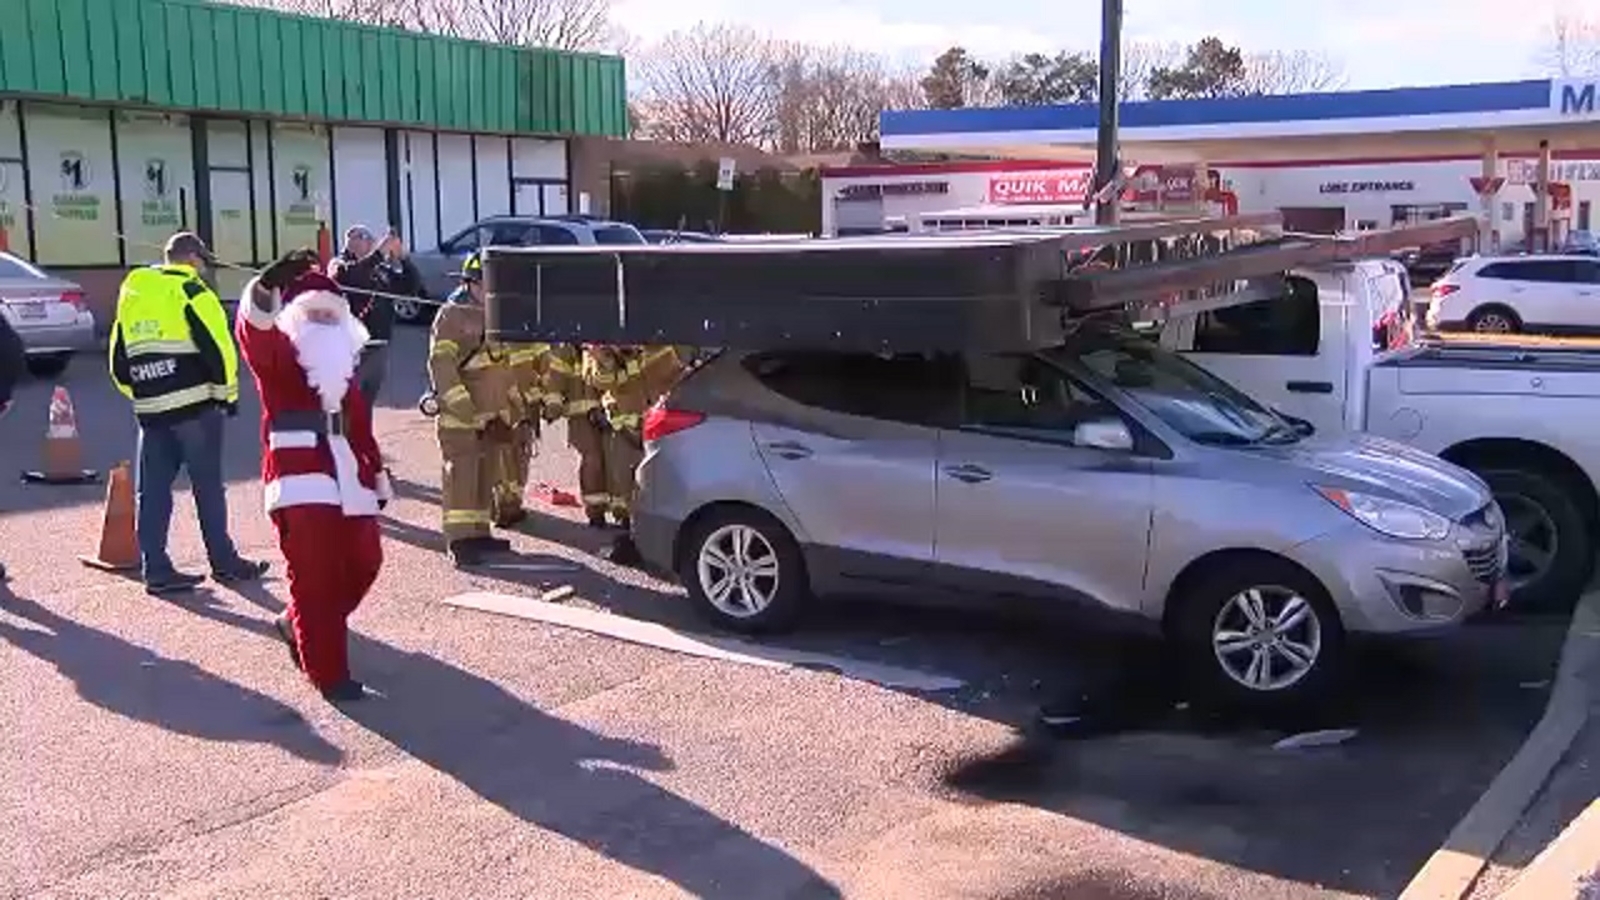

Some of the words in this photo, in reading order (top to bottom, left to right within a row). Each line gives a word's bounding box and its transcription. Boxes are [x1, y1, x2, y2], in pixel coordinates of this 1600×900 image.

[1560, 83, 1600, 114] M
[994, 180, 1046, 195] QUIK
[130, 358, 177, 382] CHIEF
